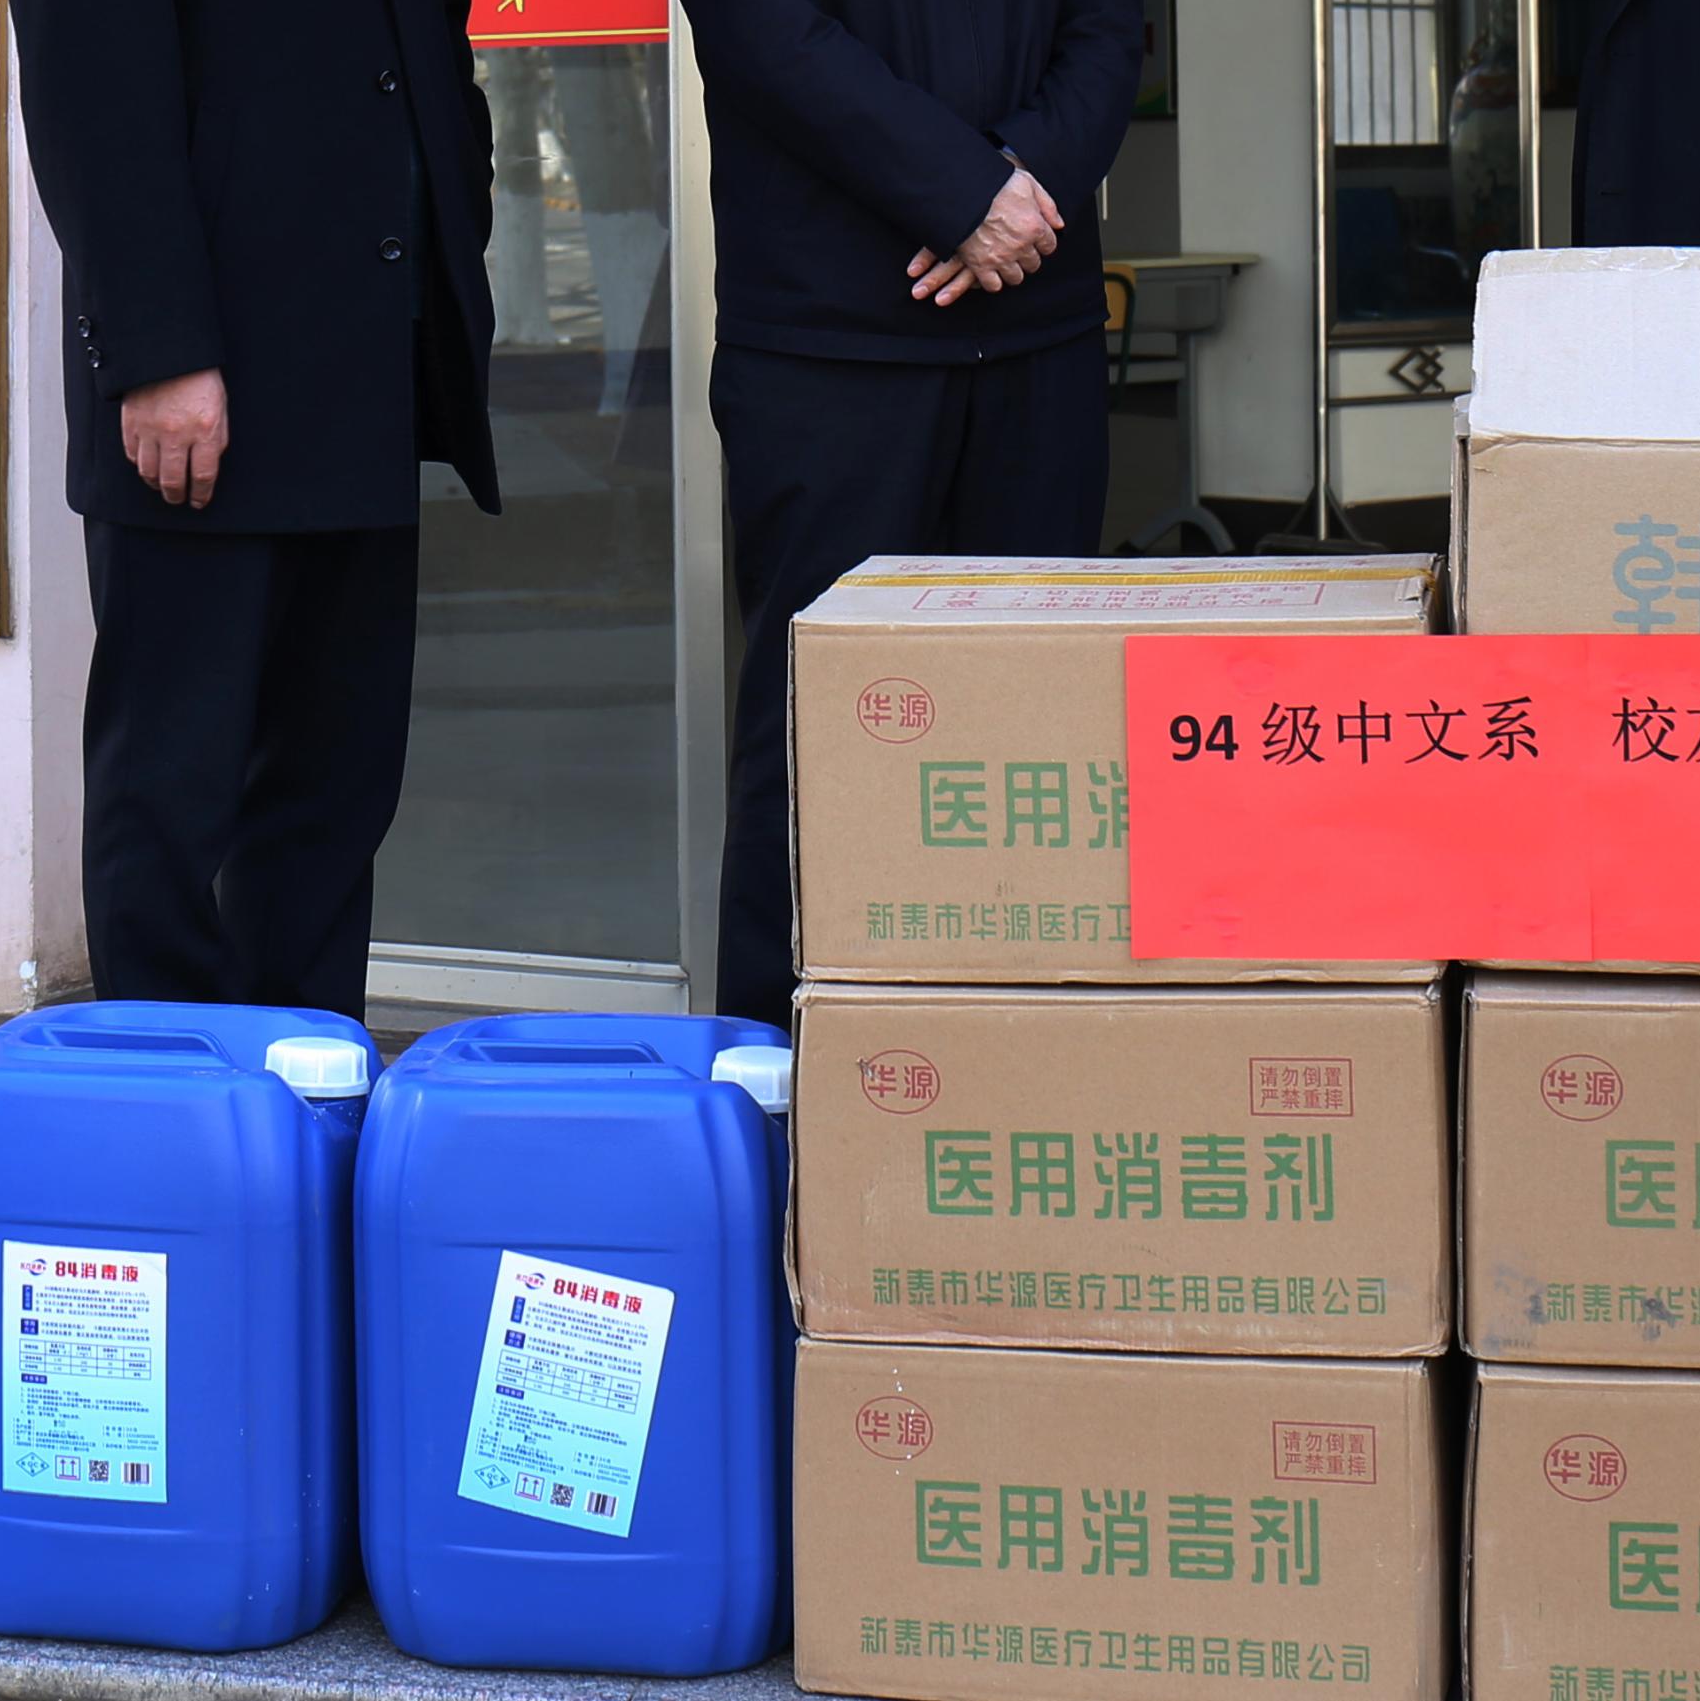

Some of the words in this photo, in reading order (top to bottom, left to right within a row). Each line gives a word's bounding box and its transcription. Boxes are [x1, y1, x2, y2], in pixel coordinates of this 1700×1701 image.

[863, 692, 929, 729] 华源
[1169, 715, 1239, 761] 94
[1261, 696, 1540, 765] 级中文系
[867, 1064, 933, 1099] 华源
[1259, 1066, 1343, 1087] 请勿倒置
[1547, 1069, 1616, 1106] 华源
[1259, 1088, 1344, 1109] 严禁重摔
[924, 1131, 1335, 1222] 医用消毒剂
[54, 1260, 139, 1283] 84消毒液
[553, 1278, 643, 1315] 84消毒液
[872, 1268, 1387, 1316] 新泰市华源医疗卫生用品有限公司
[861, 1408, 927, 1447] 华源
[1282, 1430, 1366, 1455] 请勿倒置
[1282, 1453, 1367, 1477] 严禁重摔
[1550, 1449, 1620, 1487] 华源
[915, 1480, 1322, 1586] 医用消毒剂
[861, 1616, 1372, 1683] 新泰市华源医疗卫生用品有限公司
